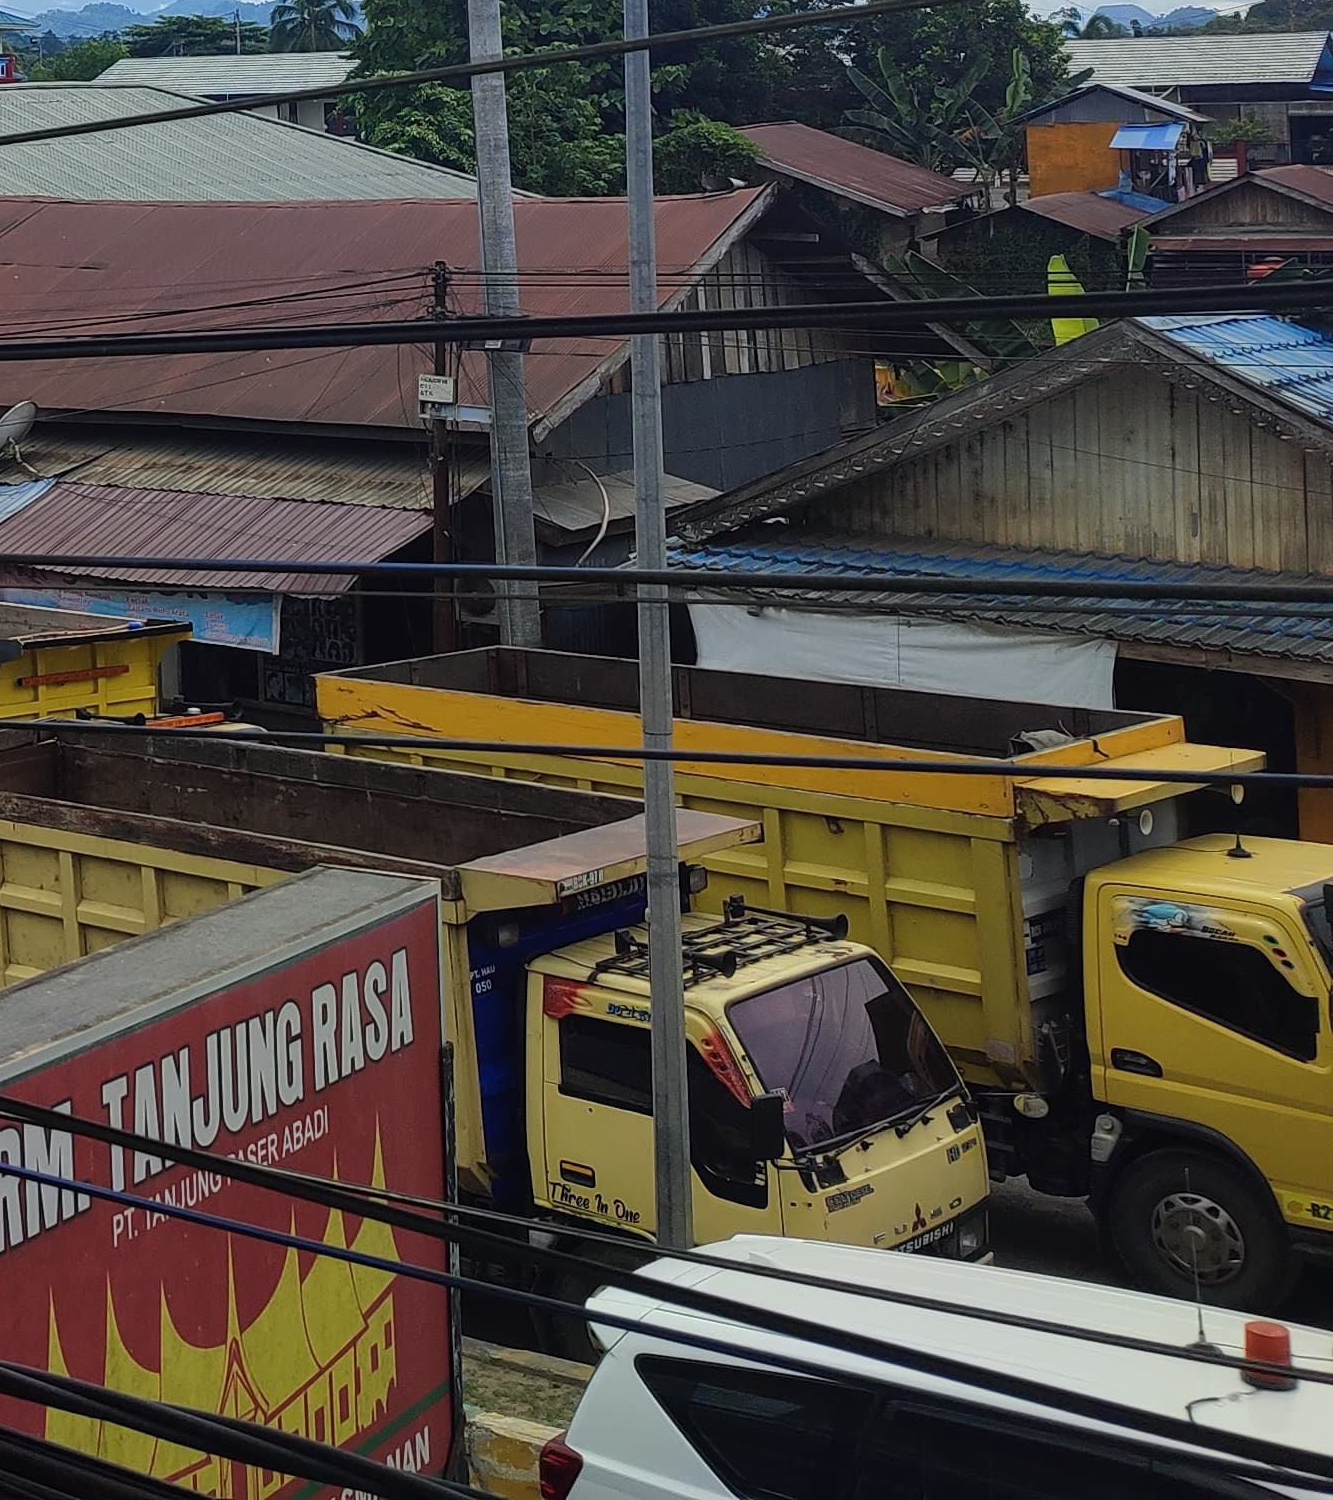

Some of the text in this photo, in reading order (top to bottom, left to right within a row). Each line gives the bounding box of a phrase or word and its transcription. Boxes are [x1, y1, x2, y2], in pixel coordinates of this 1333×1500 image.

[101, 1000, 305, 1194] TANJUNG
[311, 946, 415, 1093] RASA
[112, 1206, 139, 1248] PT.
[145, 1168, 222, 1230] TANJUNG
[282, 1105, 330, 1159] ABADI
[548, 1181, 641, 1224] Three In One
